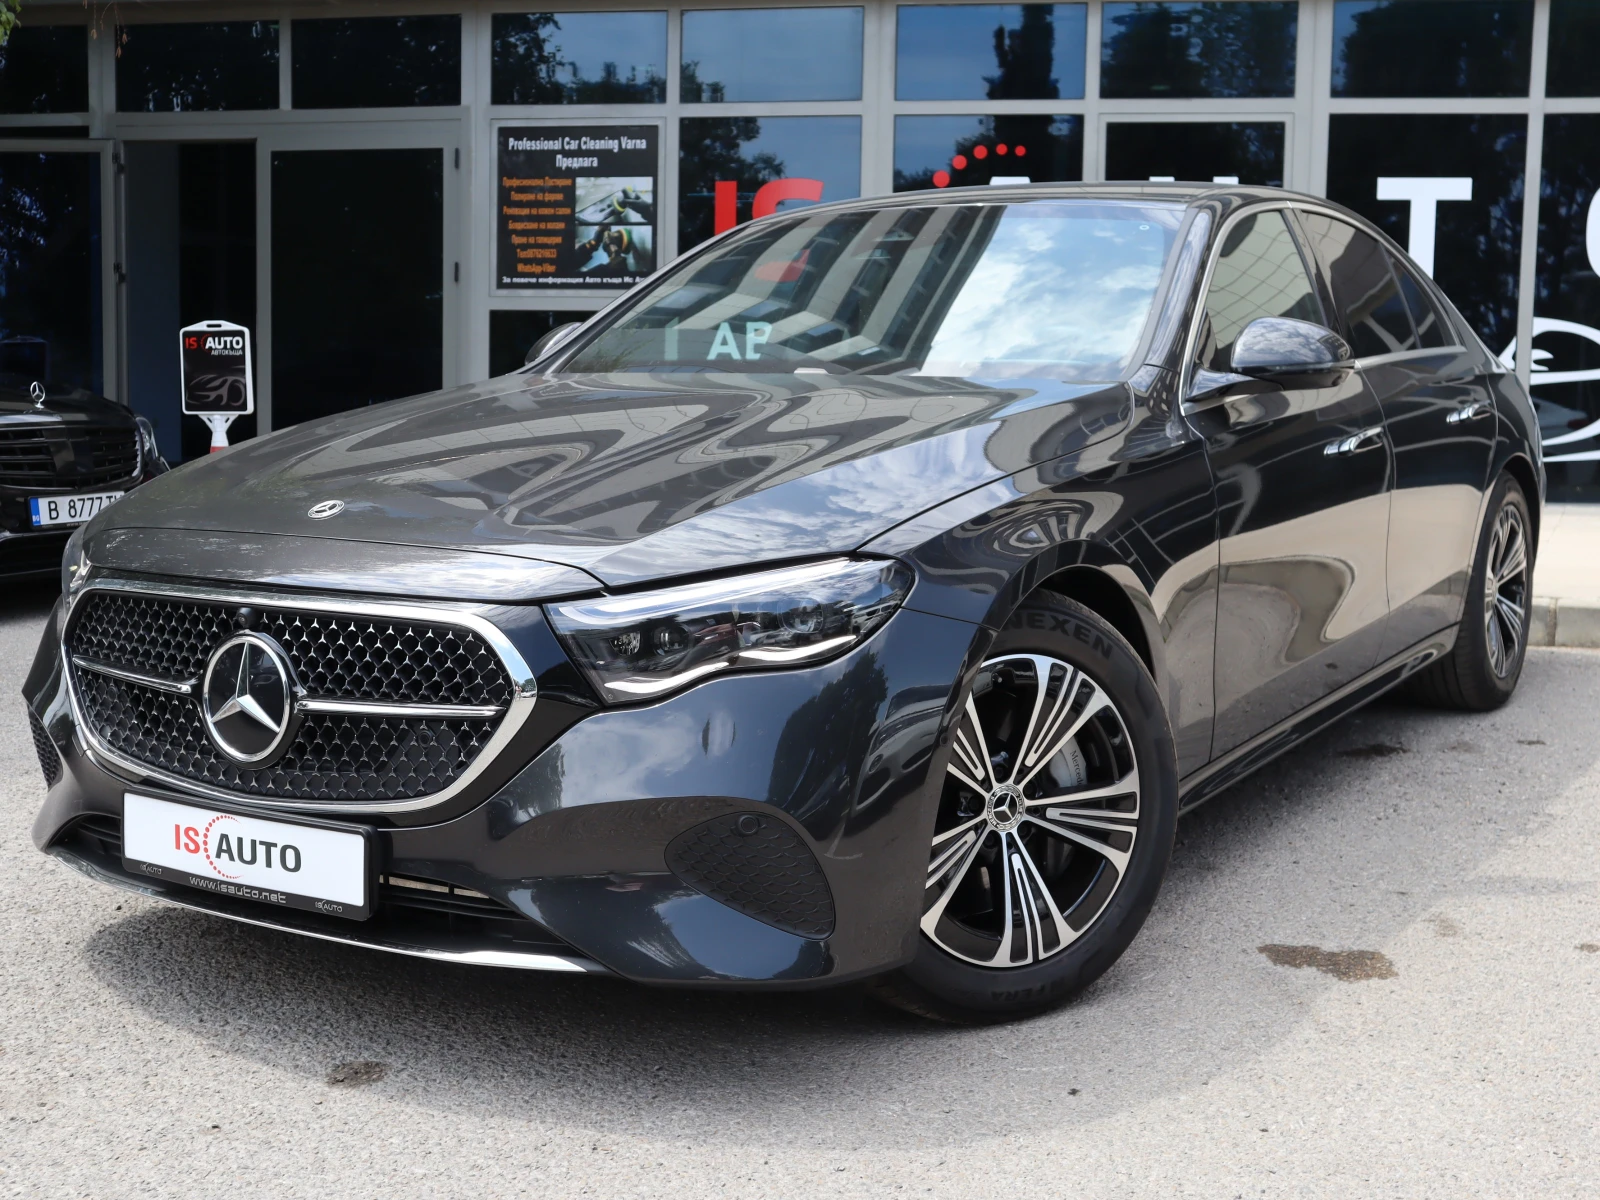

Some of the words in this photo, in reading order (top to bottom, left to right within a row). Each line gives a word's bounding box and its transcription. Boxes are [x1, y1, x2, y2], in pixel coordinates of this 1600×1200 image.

[508, 137, 562, 150] Professional
[563, 137, 579, 150] Car
[580, 136, 619, 153] Cleaning
[620, 136, 647, 149] Varna
[556, 154, 598, 170] Предлага
[185, 337, 198, 349] IS
[205, 336, 243, 349] AUTO
[48, 500, 59, 521] B
[1002, 611, 1114, 660] NEXEN
[174, 823, 200, 854] IS
[215, 833, 301, 873] AUTO
[189, 876, 286, 903] www.isauto.net
